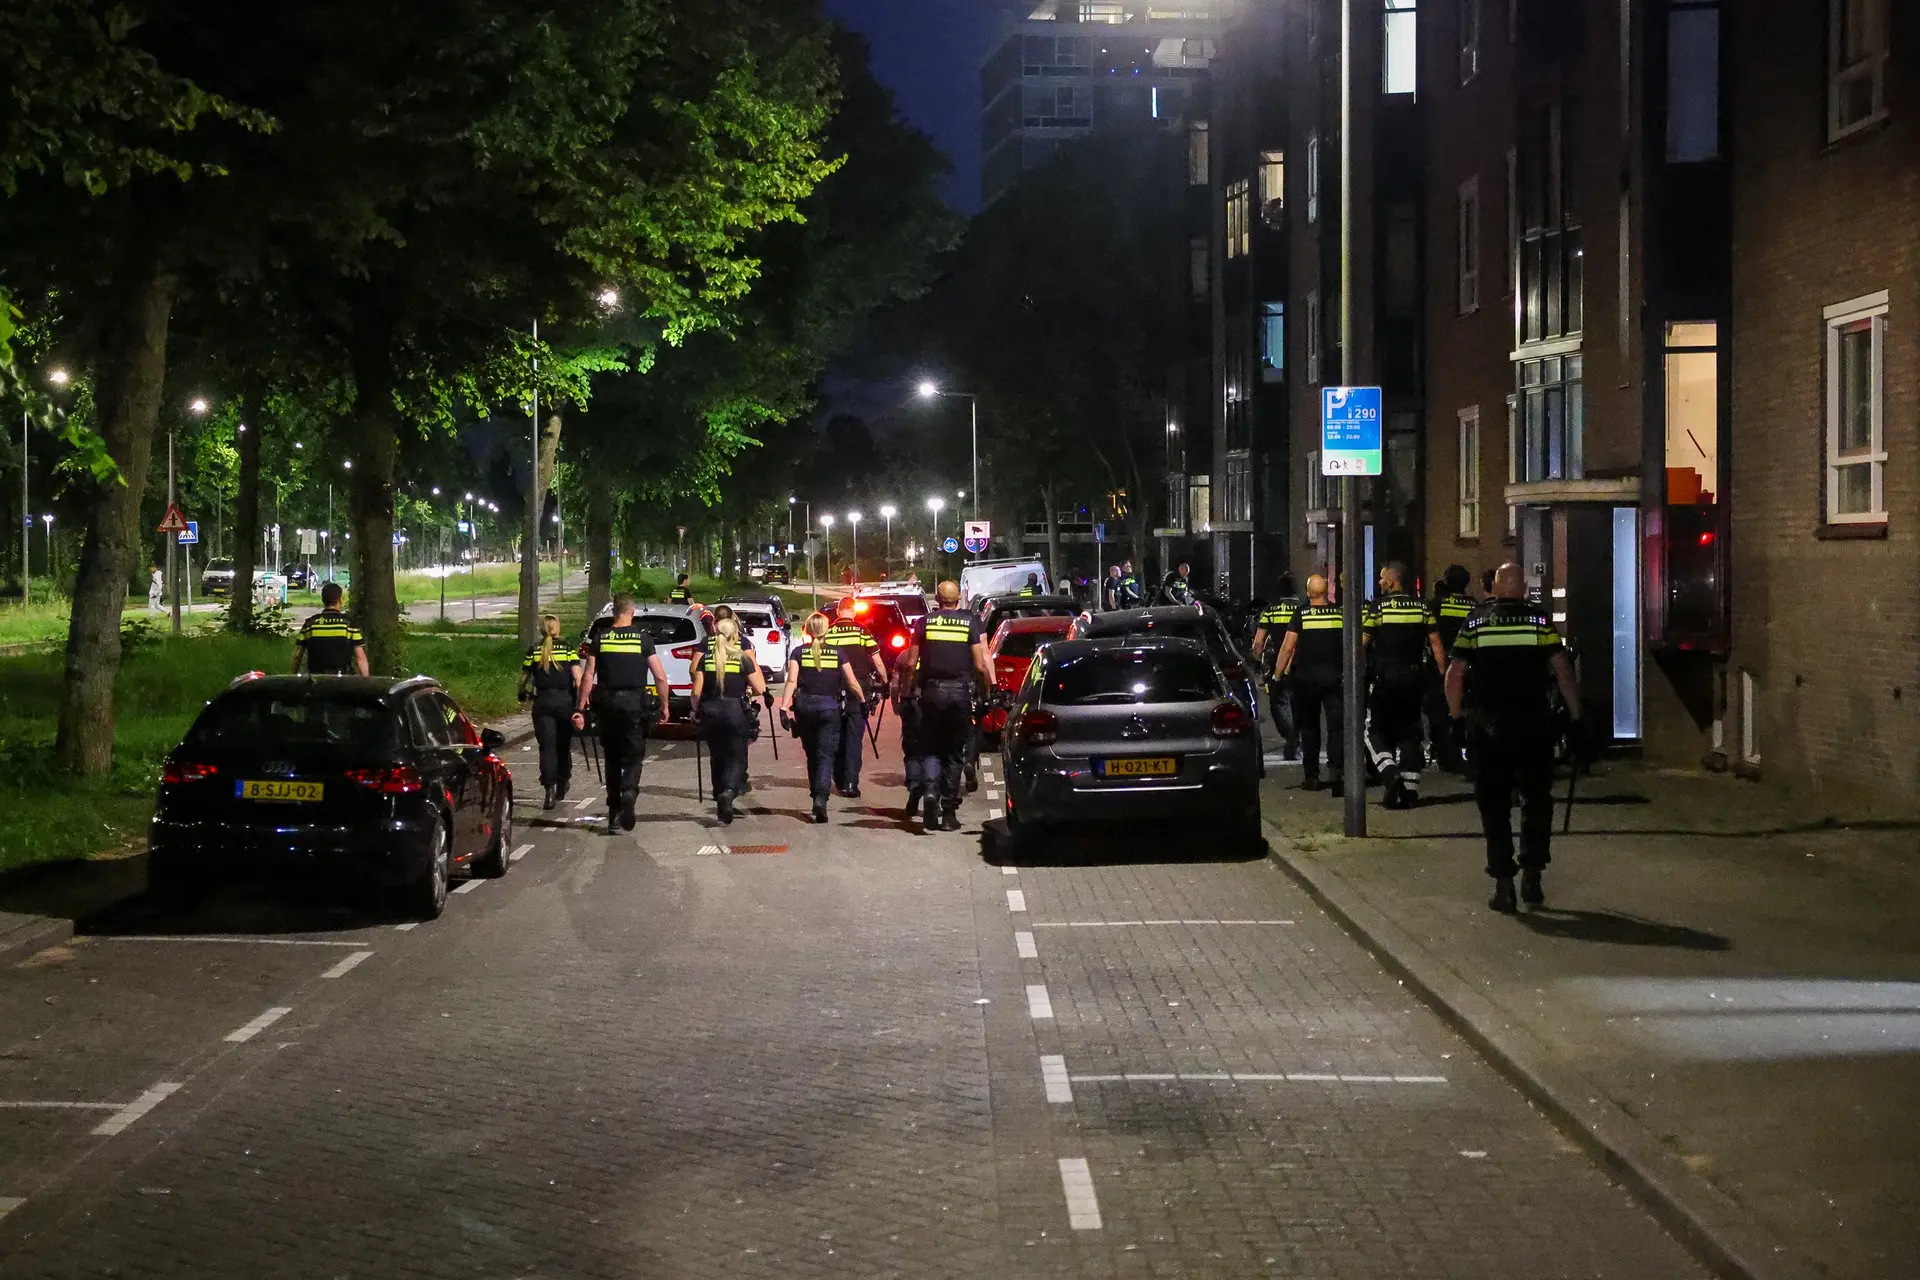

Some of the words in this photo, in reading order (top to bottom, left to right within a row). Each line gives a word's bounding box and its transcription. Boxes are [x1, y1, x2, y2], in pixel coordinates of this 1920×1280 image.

[1354, 408, 1376, 419] 290
[1110, 760, 1170, 773] H-021-KT
[250, 783, 317, 799] 8-SJJ-02
